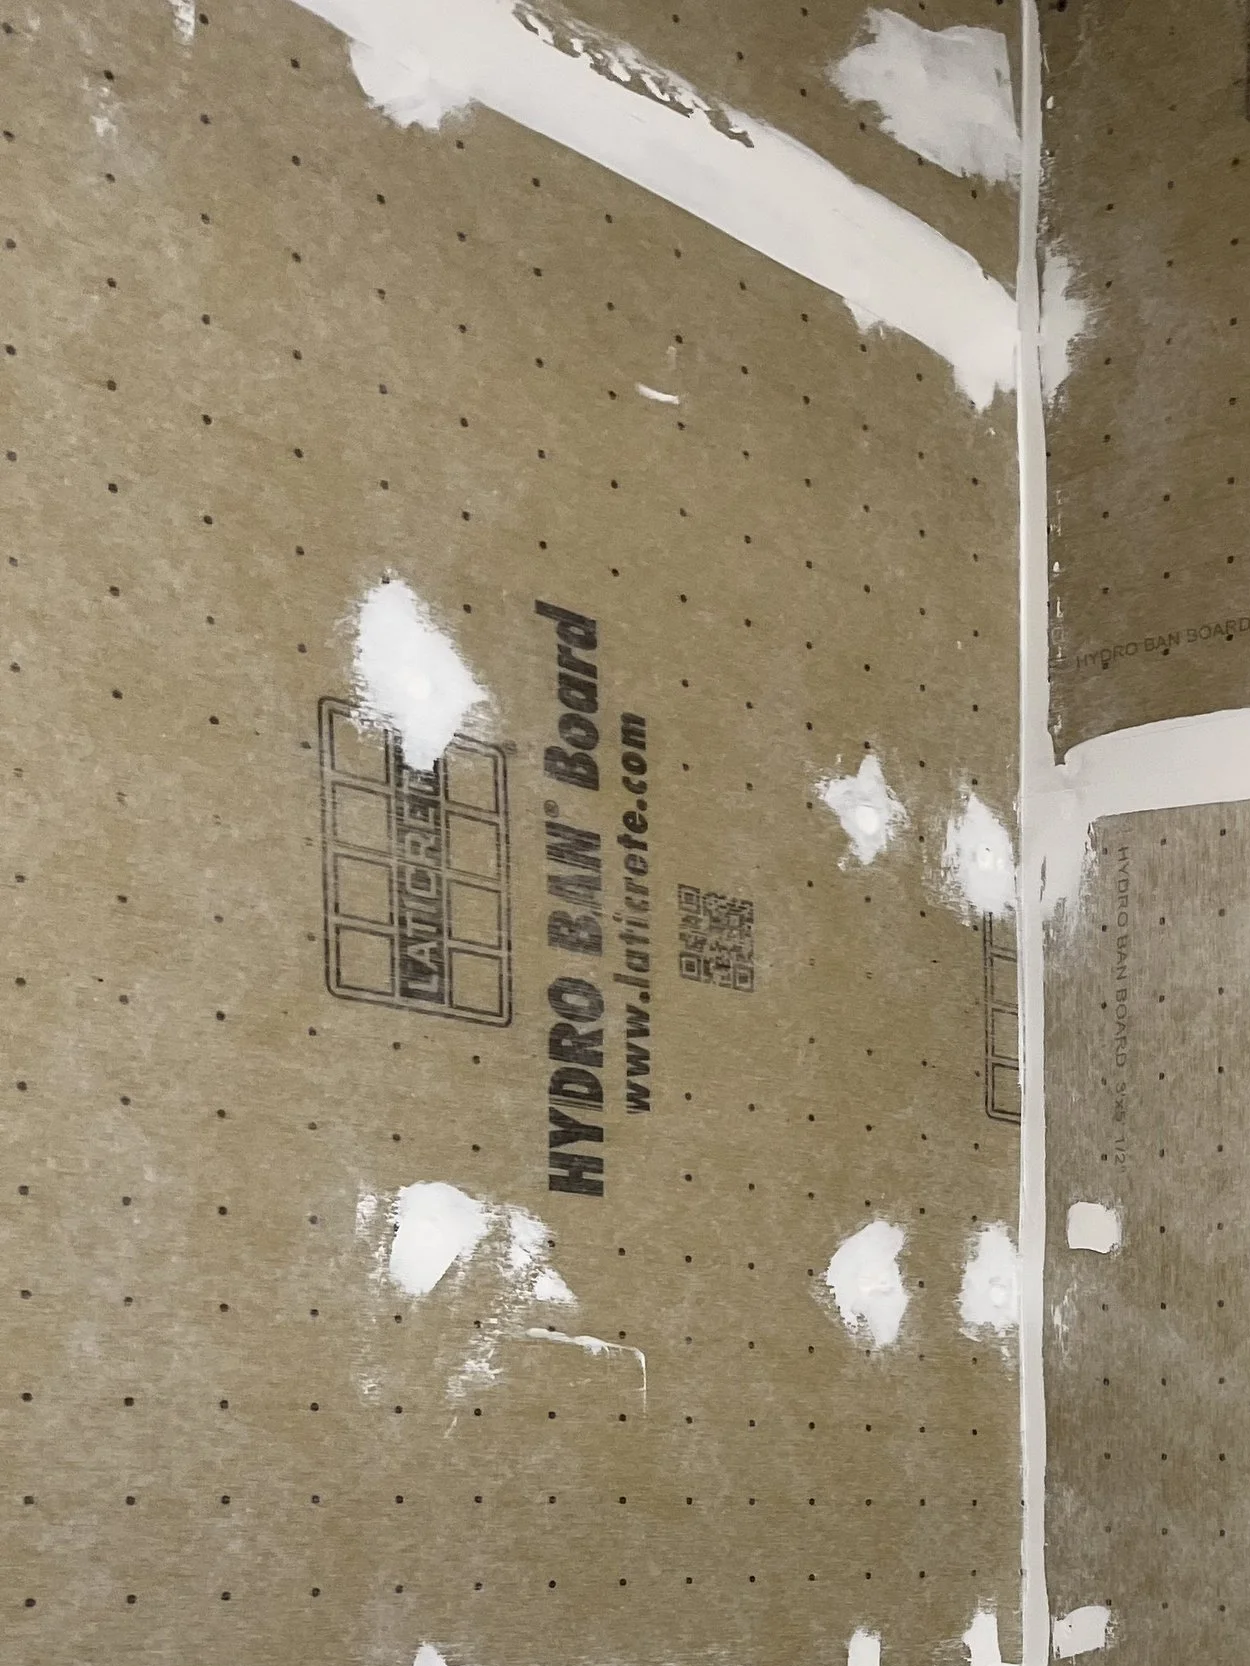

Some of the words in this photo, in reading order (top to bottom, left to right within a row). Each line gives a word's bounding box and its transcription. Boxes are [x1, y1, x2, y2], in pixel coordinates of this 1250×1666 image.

[535, 599, 601, 793] Board
[1075, 640, 1139, 669] HYDRO
[1143, 629, 1181, 654] BAN
[403, 768, 439, 993] LATICRET
[613, 711, 654, 1115] www.laticrete.com
[1114, 846, 1130, 928] HYDRO
[1114, 934, 1130, 982] BAN
[548, 976, 605, 1197] HYDRO
[1114, 987, 1129, 1069] BOARD
